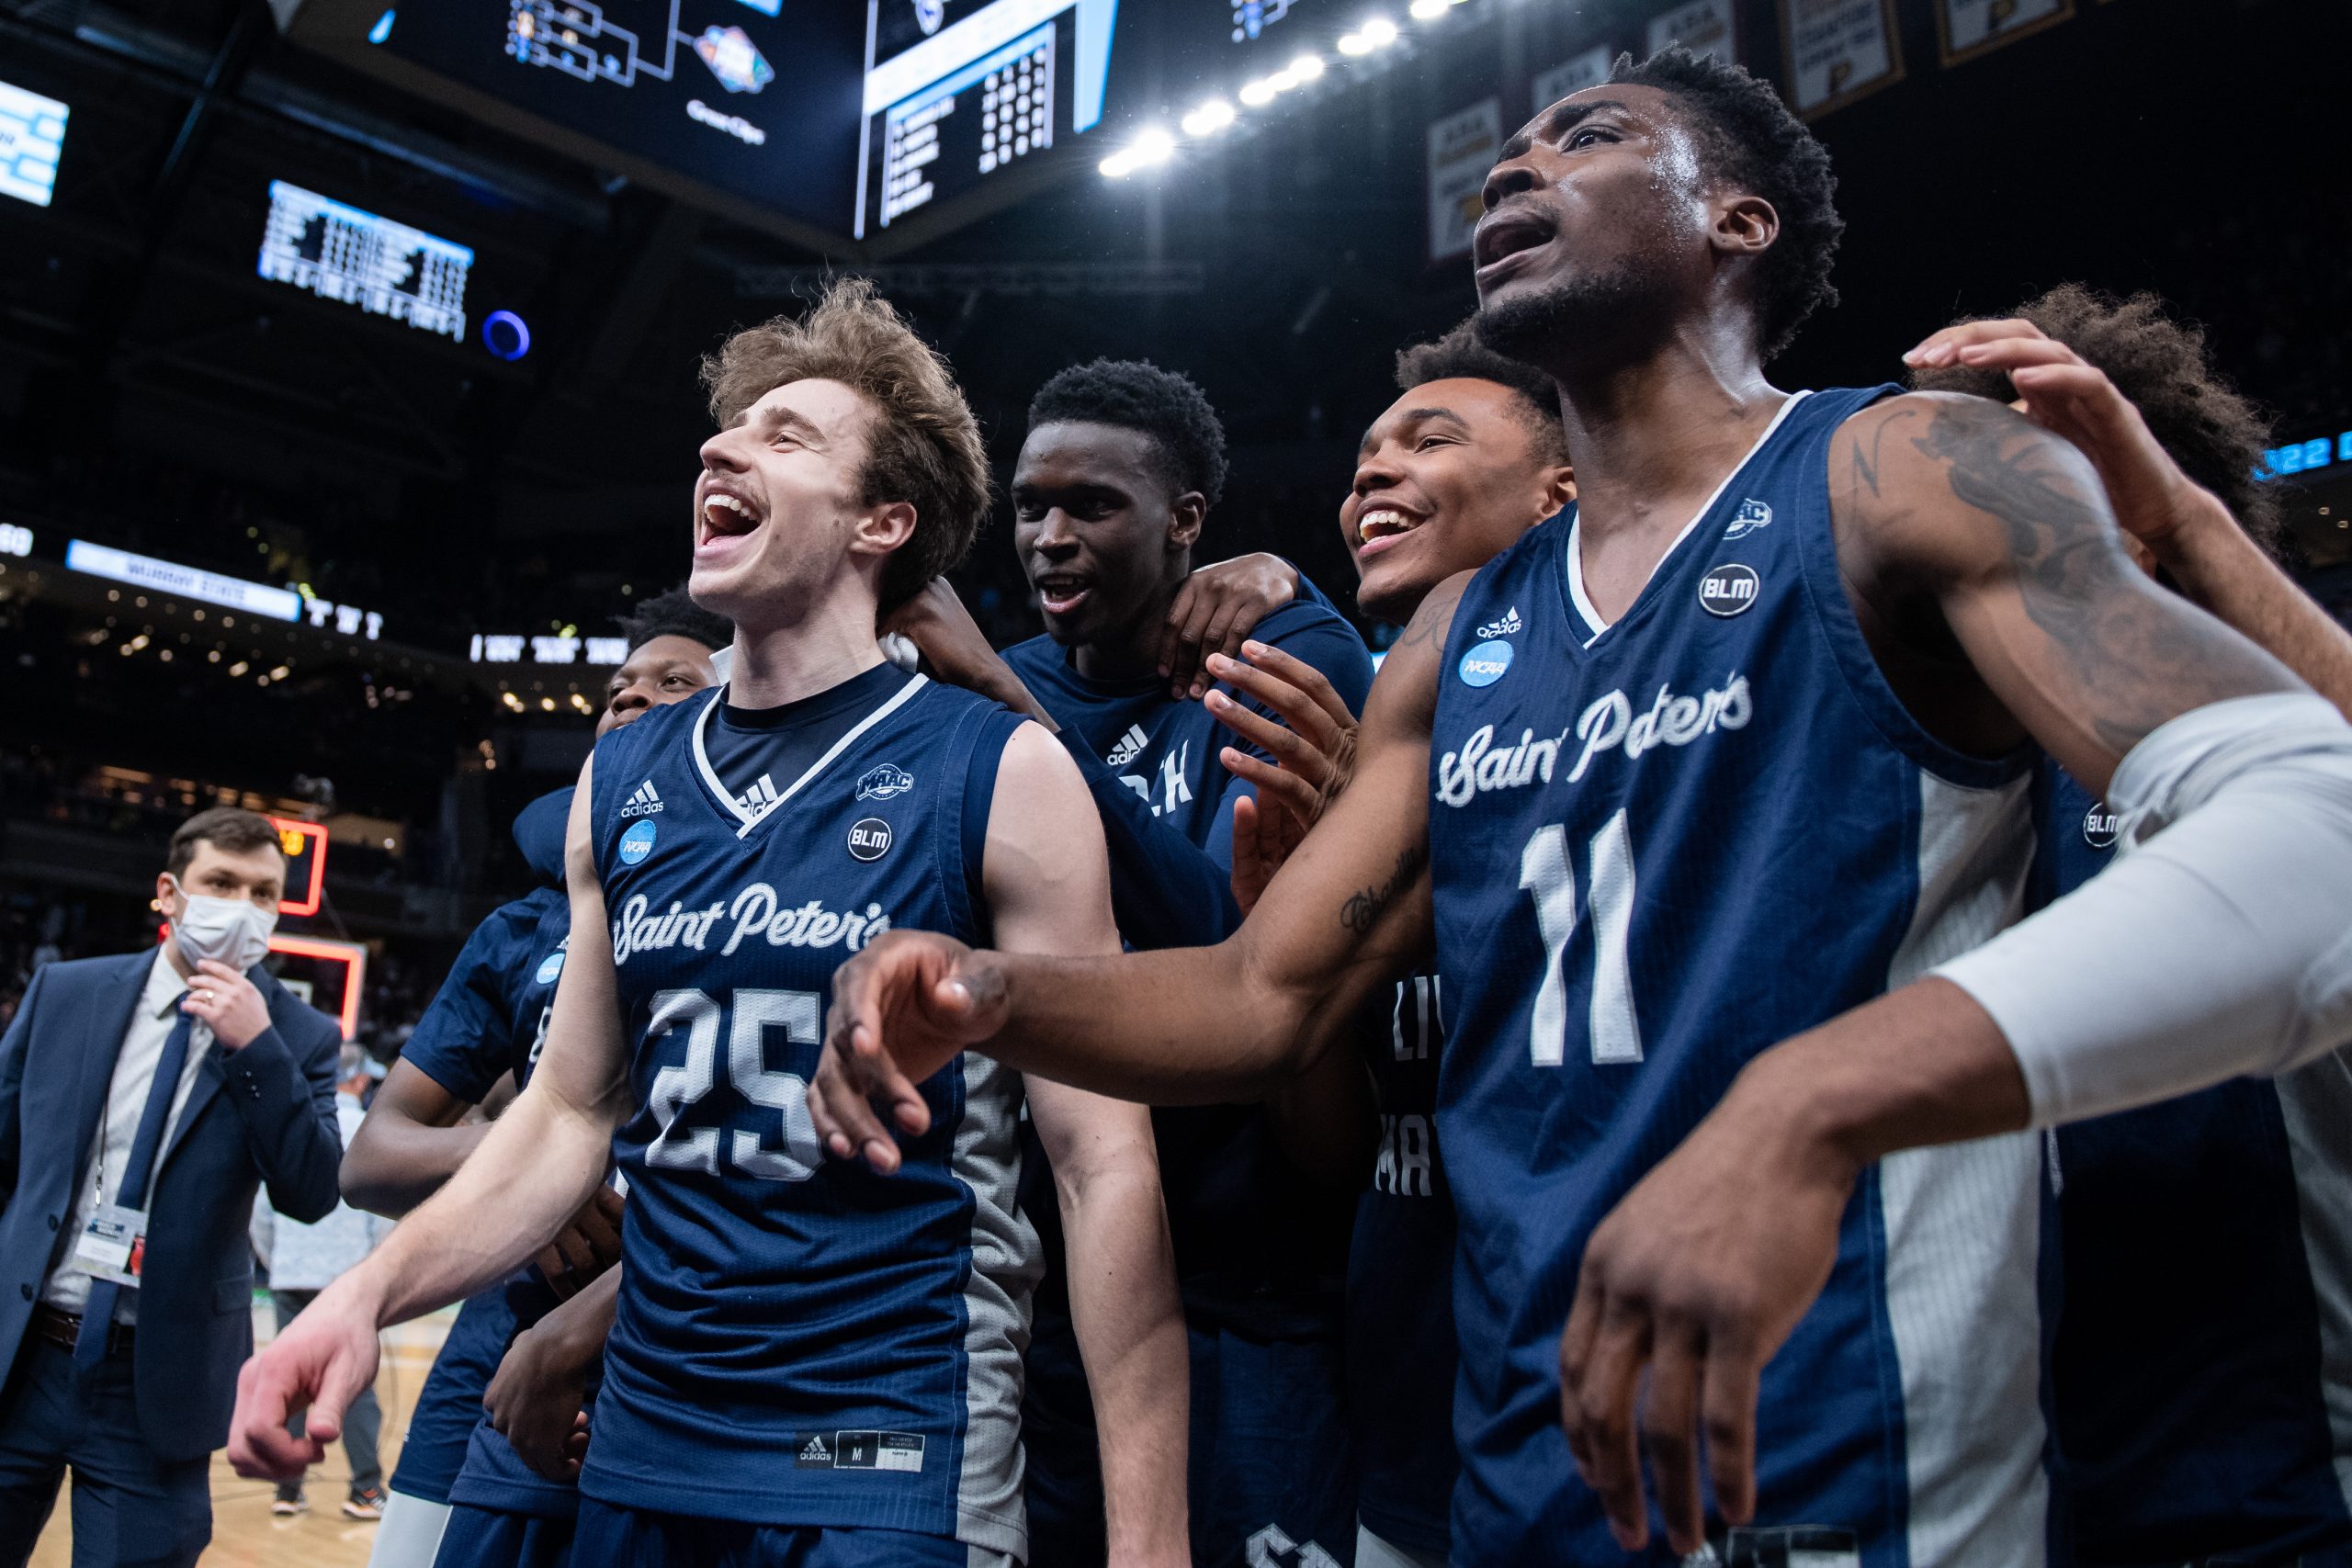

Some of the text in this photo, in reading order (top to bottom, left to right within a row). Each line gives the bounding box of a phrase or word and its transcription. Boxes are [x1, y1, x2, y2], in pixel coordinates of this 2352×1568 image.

[1703, 578, 1753, 600] BLM
[1464, 660, 1507, 674] NCAA
[620, 799, 664, 818] adidas
[623, 840, 652, 853] NCAA
[851, 829, 888, 850] BLM
[614, 894, 726, 965] Saint
[1519, 807, 1645, 1066] 11
[645, 987, 826, 1182] 25
[800, 1451, 831, 1461] adidas
[852, 1447, 863, 1461] M
